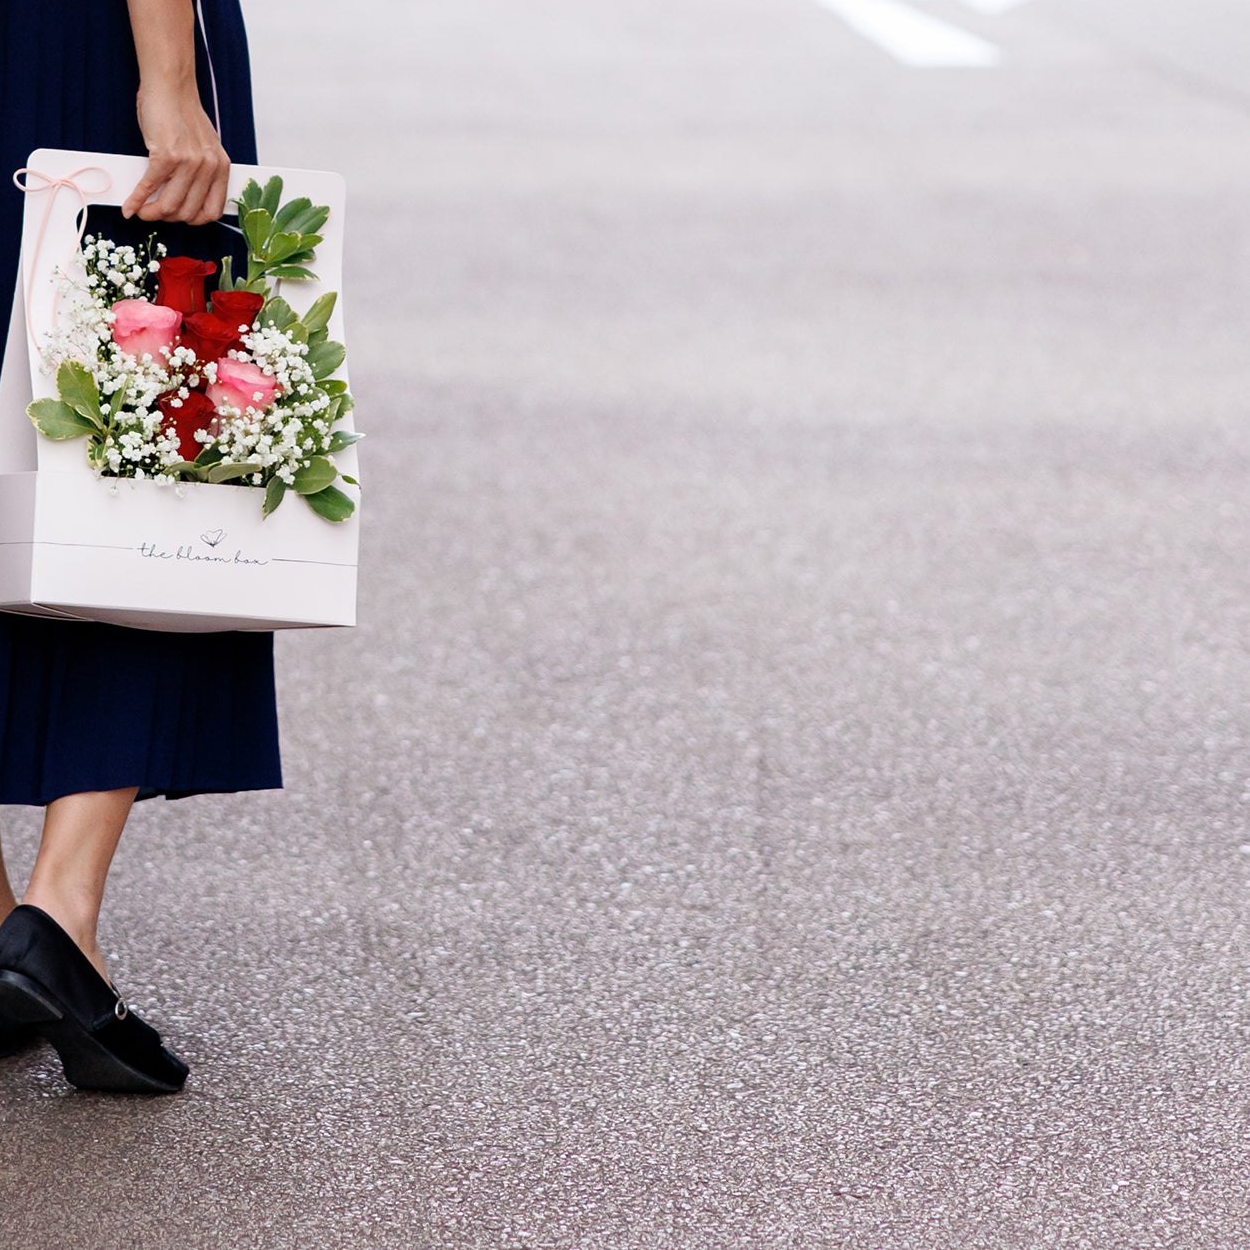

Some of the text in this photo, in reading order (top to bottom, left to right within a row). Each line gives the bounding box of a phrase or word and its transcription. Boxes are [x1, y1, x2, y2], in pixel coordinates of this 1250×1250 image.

[137, 542, 269, 566] the bloom box
